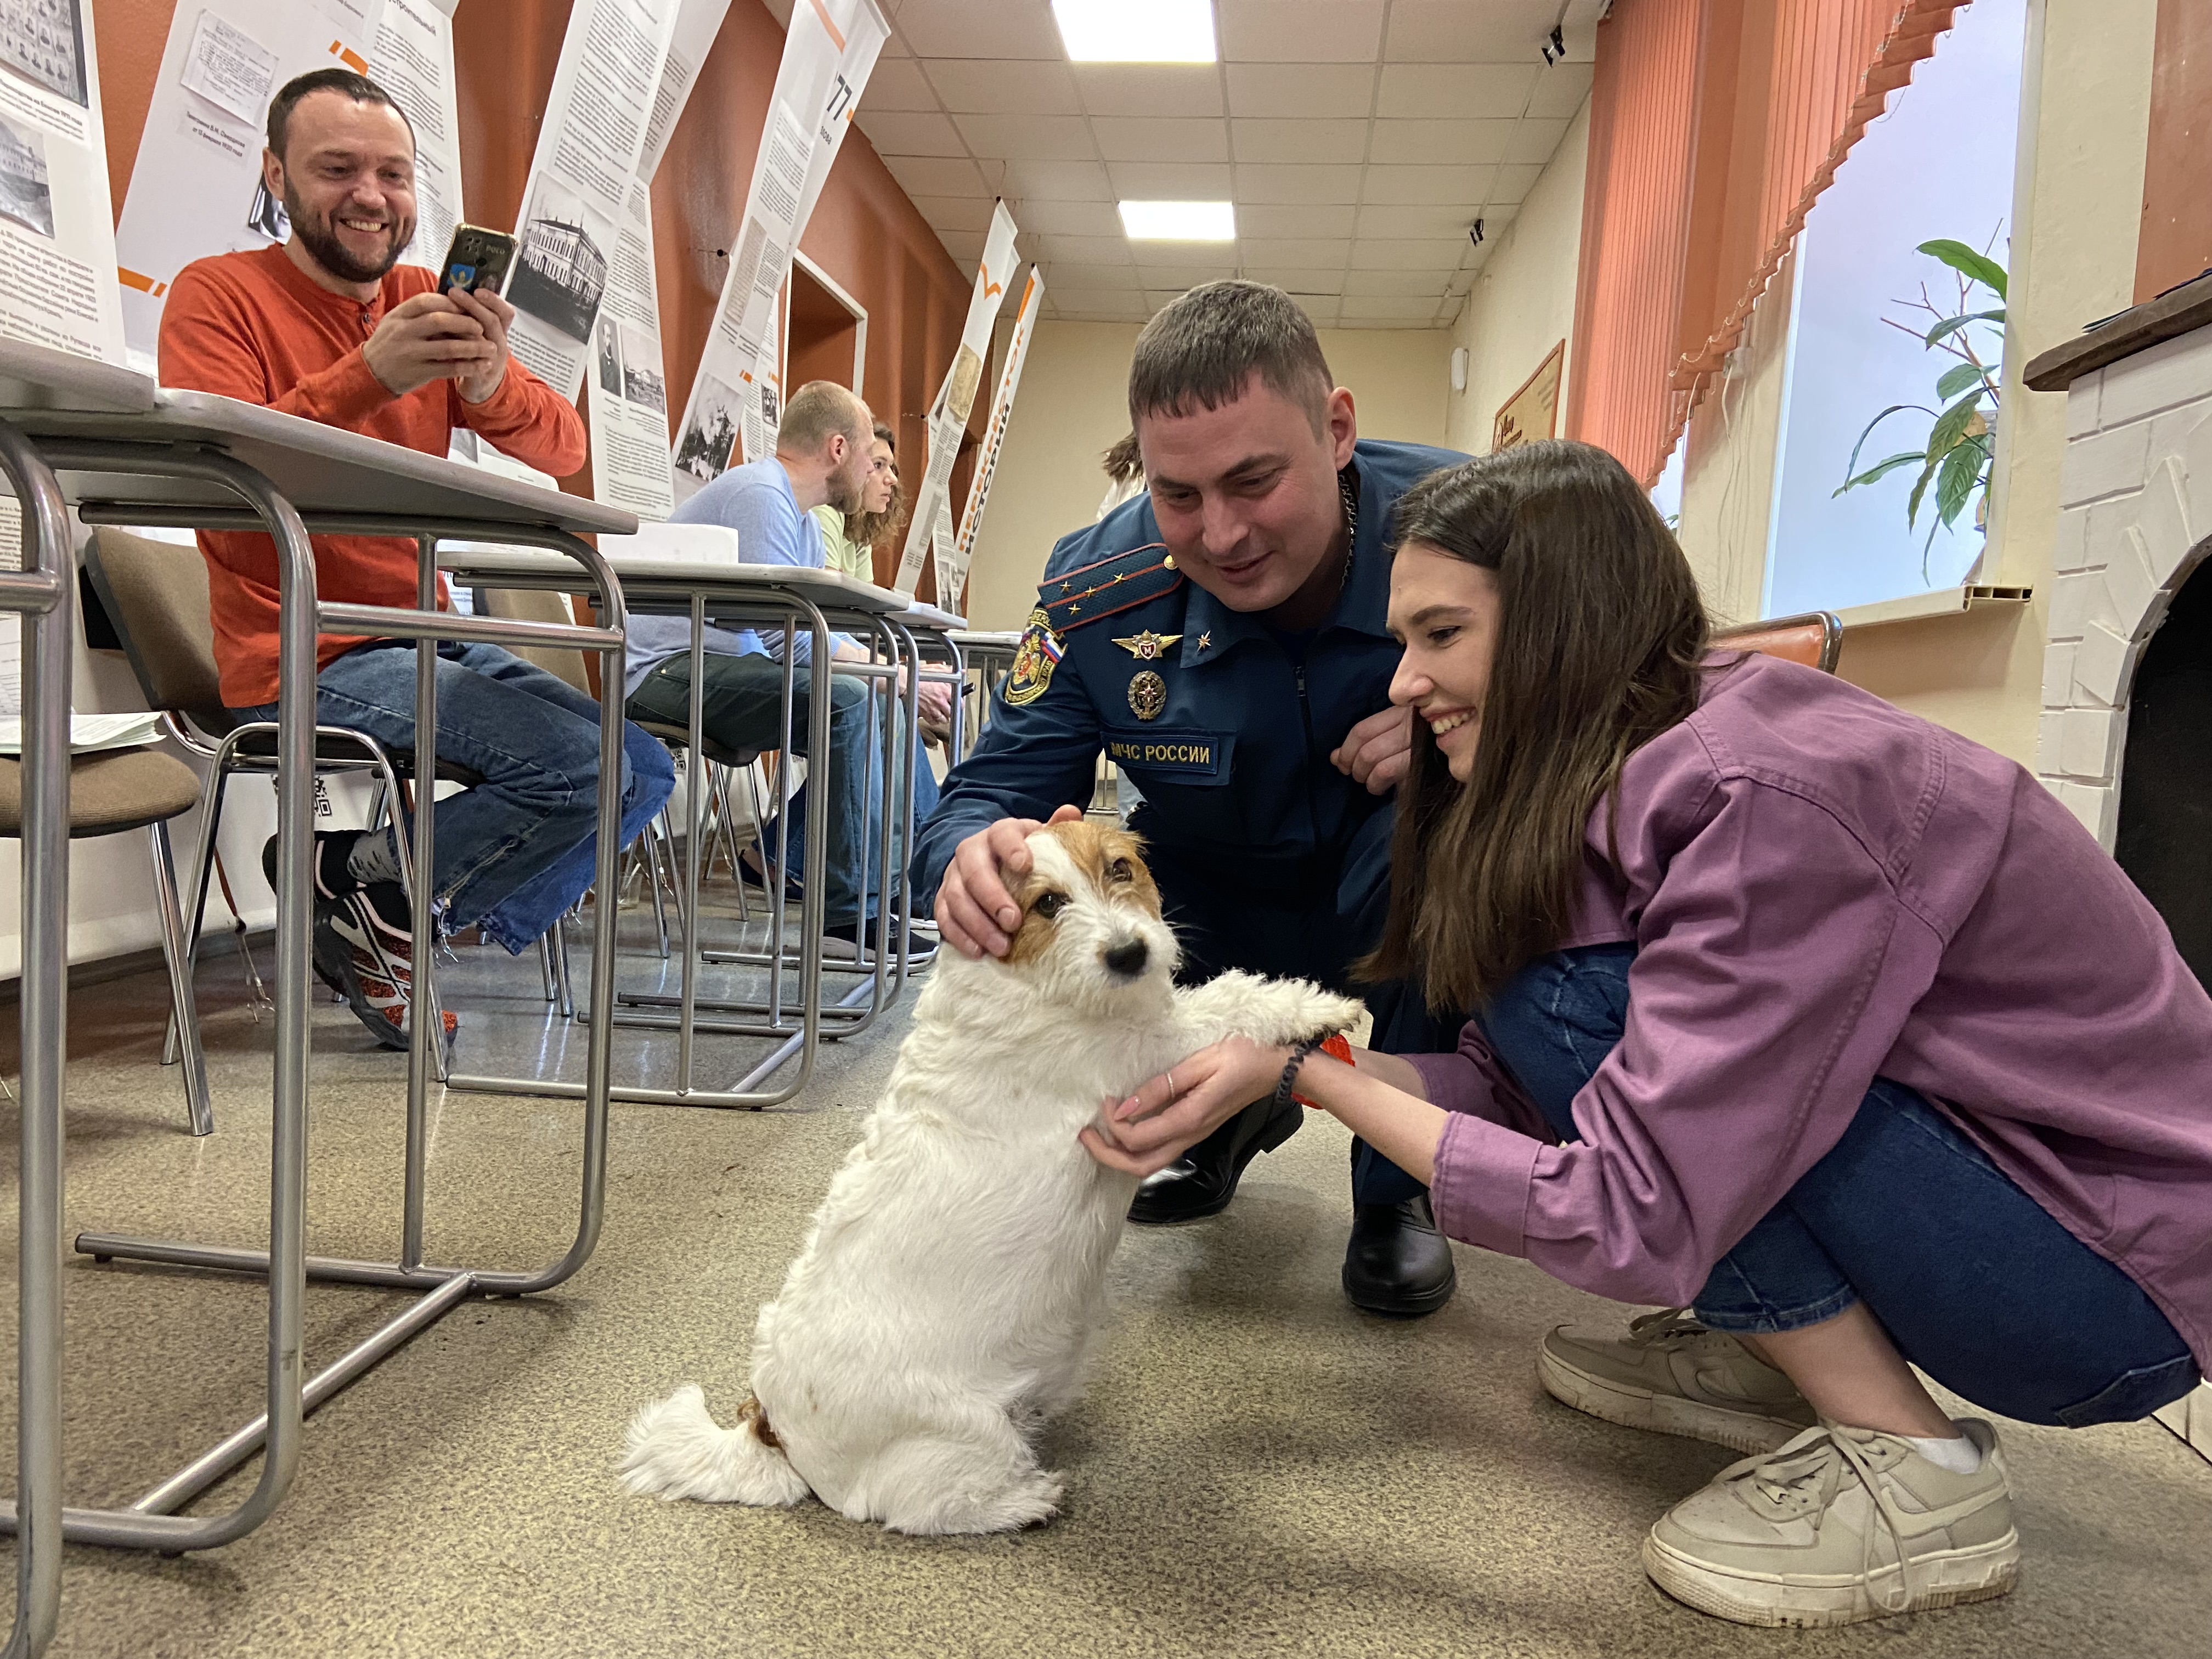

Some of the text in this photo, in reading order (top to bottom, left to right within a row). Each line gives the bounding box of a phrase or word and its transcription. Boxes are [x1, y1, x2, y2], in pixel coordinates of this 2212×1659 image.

[827, 71, 852, 121] 77
[1110, 742, 1209, 764] МЧС РОССИИ
